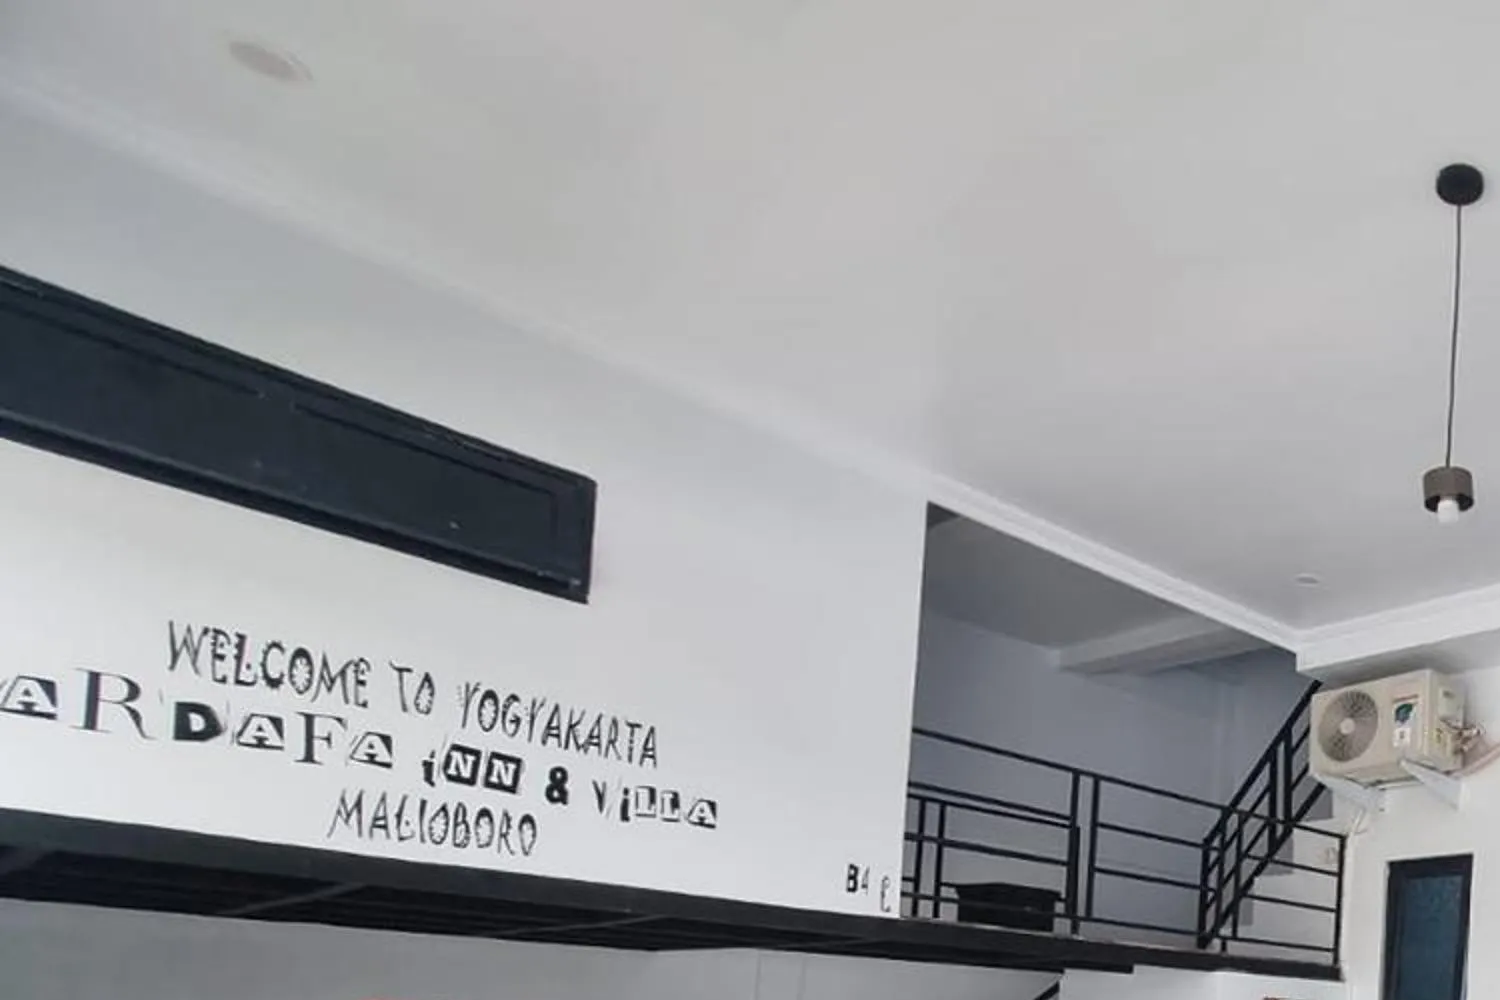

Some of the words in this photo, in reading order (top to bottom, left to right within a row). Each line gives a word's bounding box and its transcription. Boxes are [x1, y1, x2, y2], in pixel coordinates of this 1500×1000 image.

[168, 620, 373, 710] WELCOME
[389, 660, 436, 715] TO
[458, 682, 660, 768] YOGYAKARTA
[545, 765, 570, 806] &
[329, 789, 539, 857] MALIOBORO
